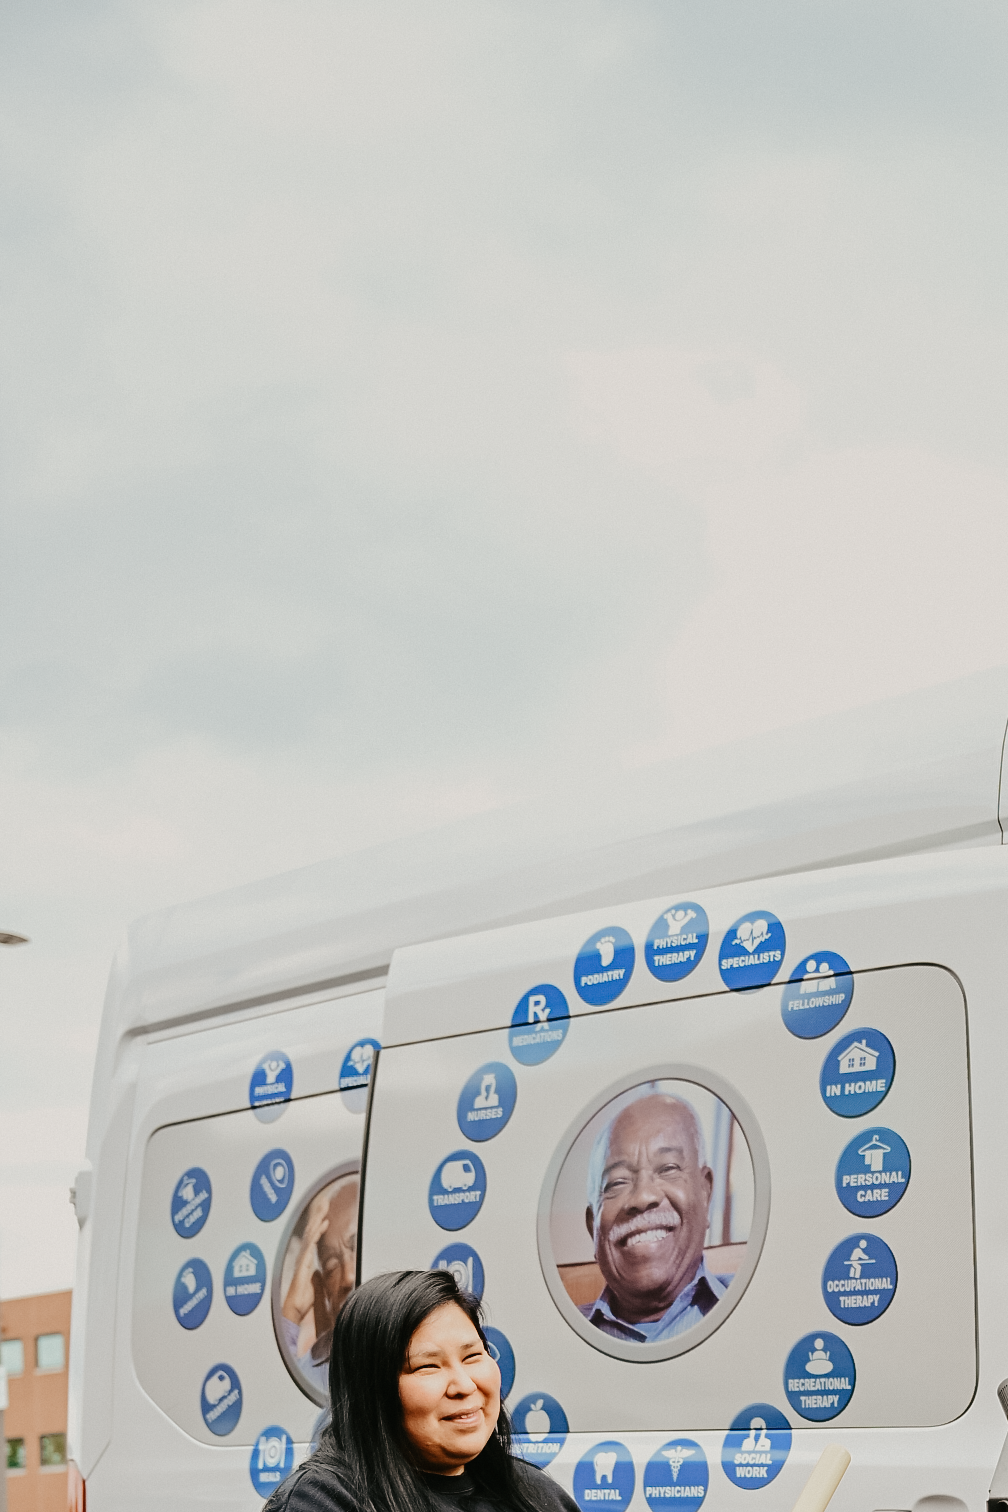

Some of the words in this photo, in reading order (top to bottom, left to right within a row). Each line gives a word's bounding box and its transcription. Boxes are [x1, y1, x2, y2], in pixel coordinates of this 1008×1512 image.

[653, 933, 699, 950] PHYSICAL
[653, 950, 697, 967] THERAPY
[721, 950, 782, 970] SPECIALISTS
[580, 968, 626, 987] PODIATRY
[787, 993, 846, 1012] FELLOWSHIP
[511, 1029, 563, 1048] MEDICATIONS
[825, 1084, 841, 1098] IN
[844, 1079, 887, 1096] HOME
[466, 1106, 504, 1122] NURSES
[842, 1171, 906, 1188] PERSONAL
[433, 1190, 482, 1206] TRANSPORT
[856, 1188, 889, 1203] CARE
[826, 1278, 893, 1294] OCCUPATIONAL
[838, 1294, 881, 1309] THERAPY
[787, 1377, 852, 1393] RECREATIONAL
[800, 1394, 840, 1409] THERAPY
[512, 1442, 561, 1454] TRITION
[733, 1452, 773, 1467] SOCIAL
[735, 1464, 768, 1479] WORK
[584, 1487, 622, 1502] DENTAL
[645, 1484, 705, 1499] PHYSICIANS
